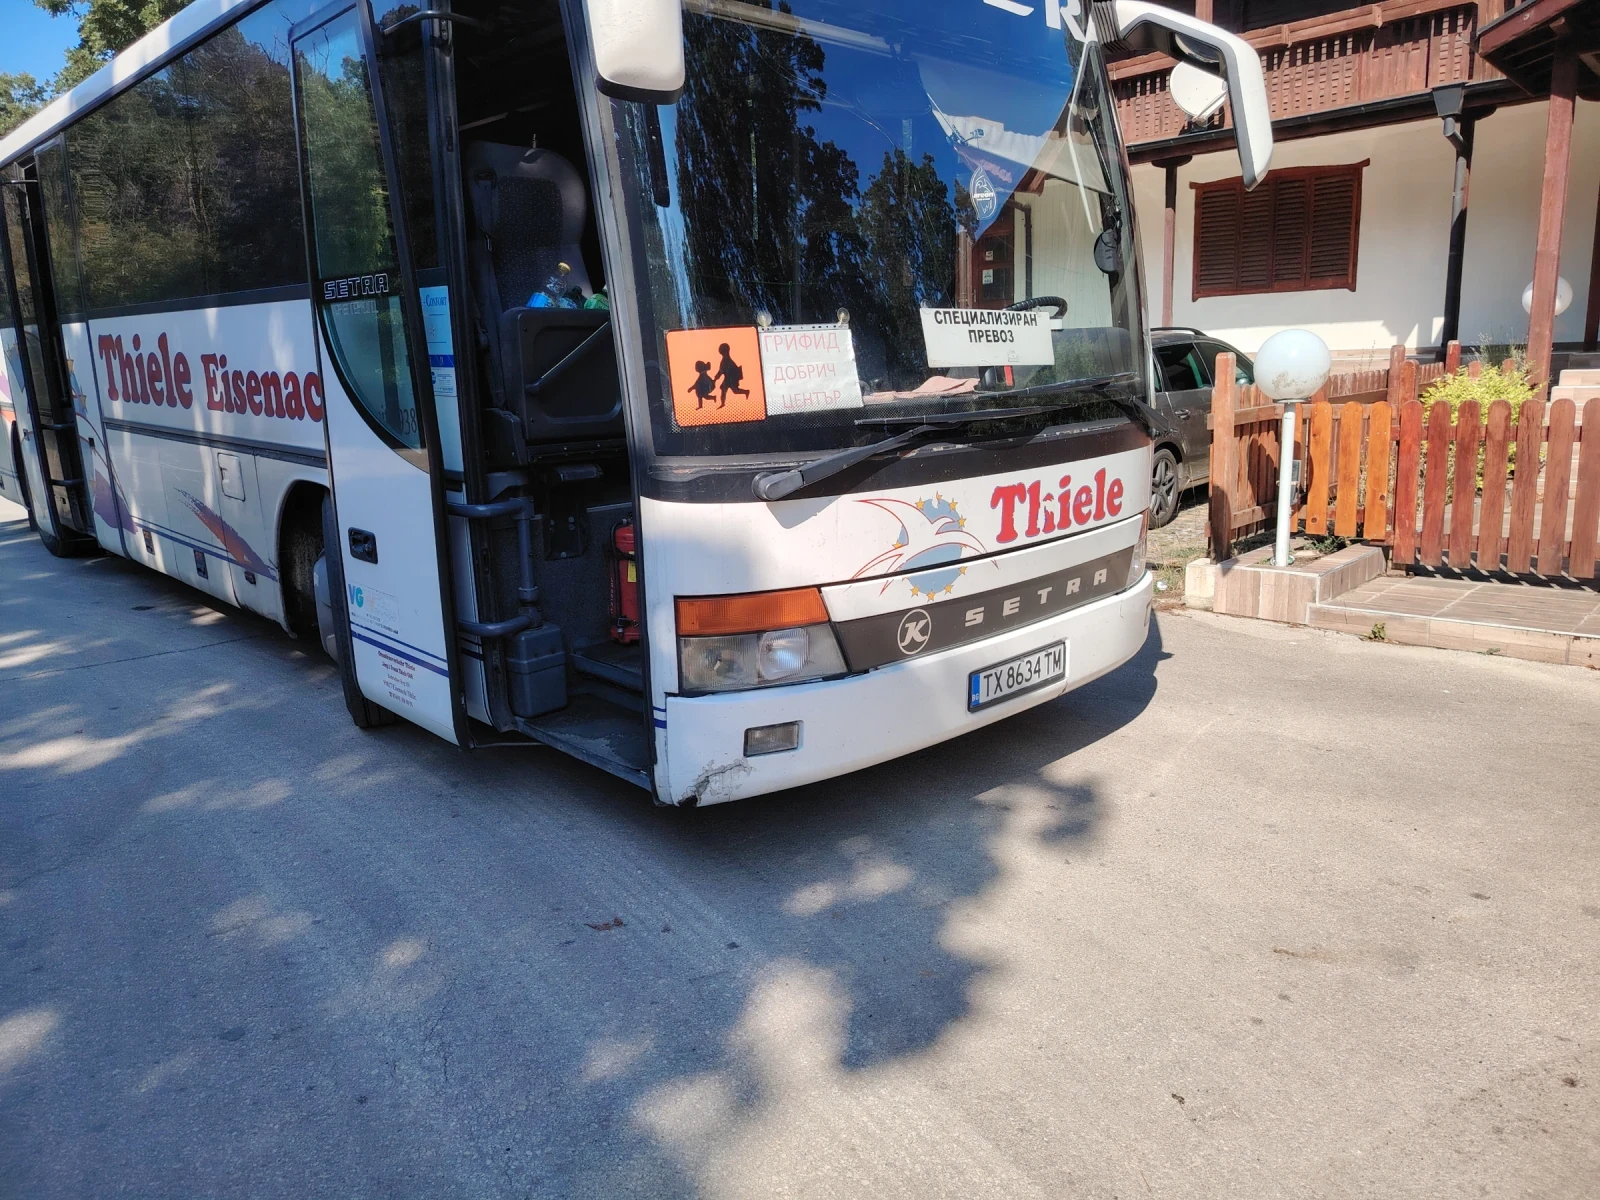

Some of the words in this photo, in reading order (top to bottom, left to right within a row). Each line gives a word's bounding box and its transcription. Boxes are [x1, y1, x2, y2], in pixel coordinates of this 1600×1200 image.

[324, 273, 389, 300] SETRA
[934, 310, 1038, 328] СПЕЦИАЛИЗИРАН
[763, 332, 841, 353] ГРИФИД
[968, 329, 1015, 343] ПРЕВОЗ
[98, 332, 193, 410] Thiele
[773, 363, 836, 384] ДОБРИЧ
[782, 390, 841, 410] ЦЕНТЪР
[990, 467, 1124, 544] Thiele
[964, 568, 1108, 627] SETRA
[984, 669, 1003, 697] TX
[1006, 656, 1041, 689] 8634
[1044, 648, 1062, 675] TM
